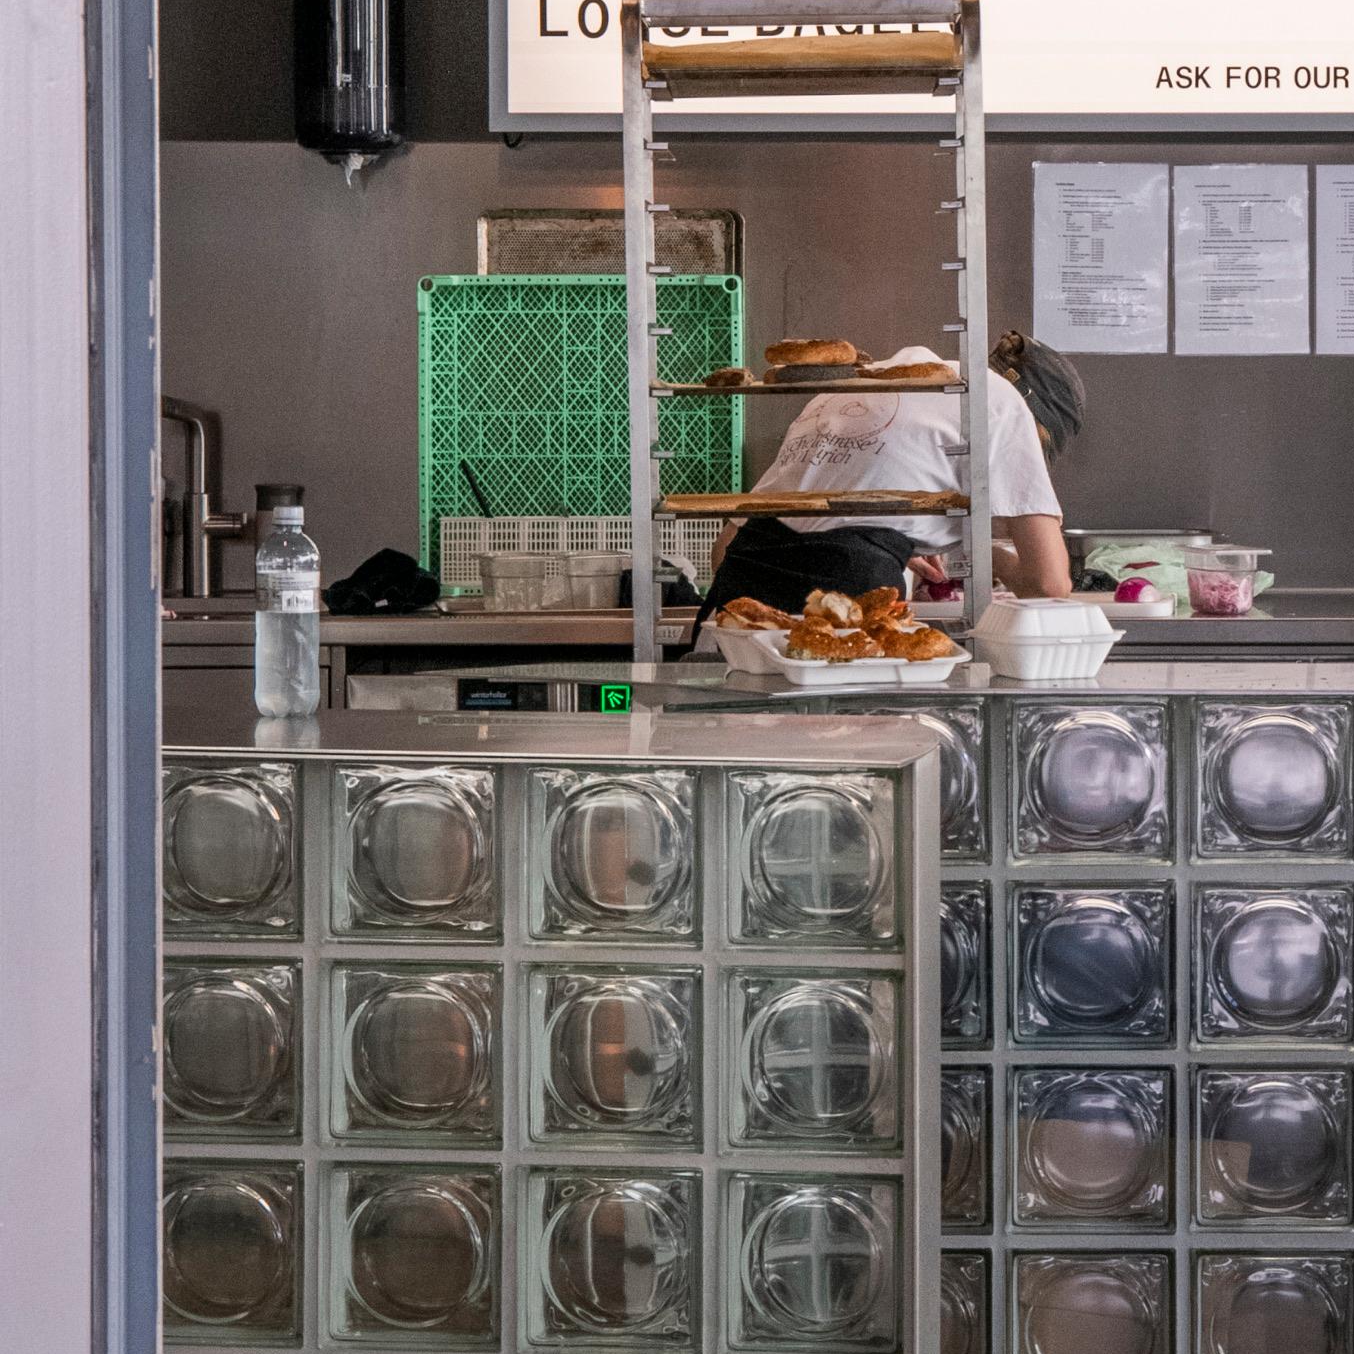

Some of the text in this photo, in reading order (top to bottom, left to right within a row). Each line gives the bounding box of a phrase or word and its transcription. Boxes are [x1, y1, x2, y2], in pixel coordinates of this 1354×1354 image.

[1155, 66, 1211, 89] ASK
[1226, 66, 1281, 89] FOR
[1294, 66, 1350, 89] OUR
